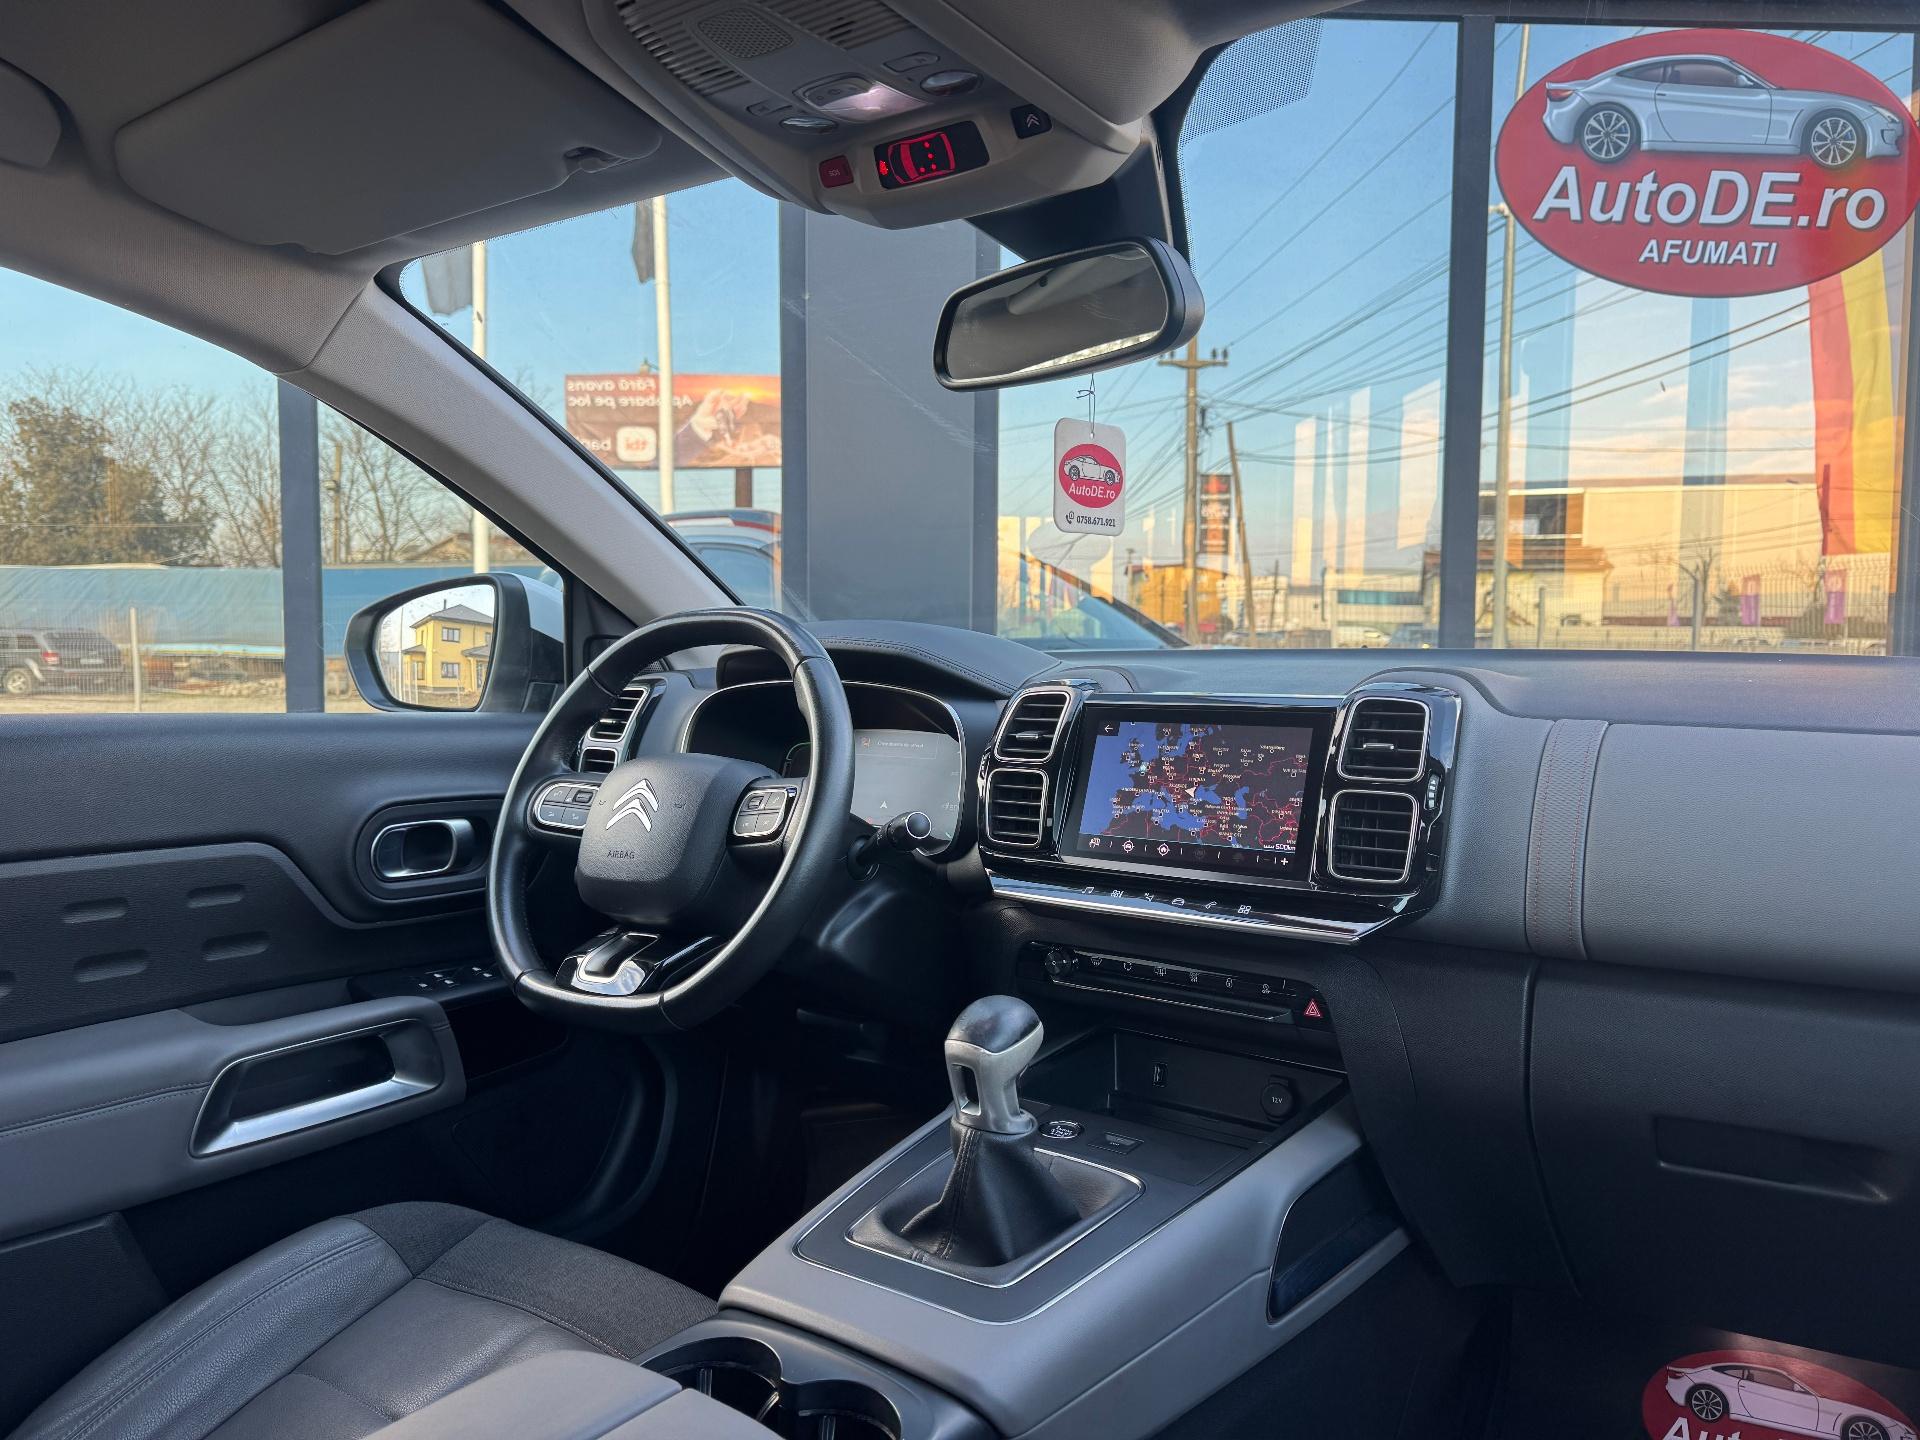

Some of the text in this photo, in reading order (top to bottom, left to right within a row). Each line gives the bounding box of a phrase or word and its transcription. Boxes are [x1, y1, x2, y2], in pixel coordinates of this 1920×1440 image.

[1532, 166, 1886, 230] AutoDE.ro
[1639, 239, 1777, 266] AFUMATI
[1069, 483, 1116, 499] AutoDE.ro
[607, 850, 635, 859] AIRBAG
[1272, 1096, 1283, 1104] 12V
